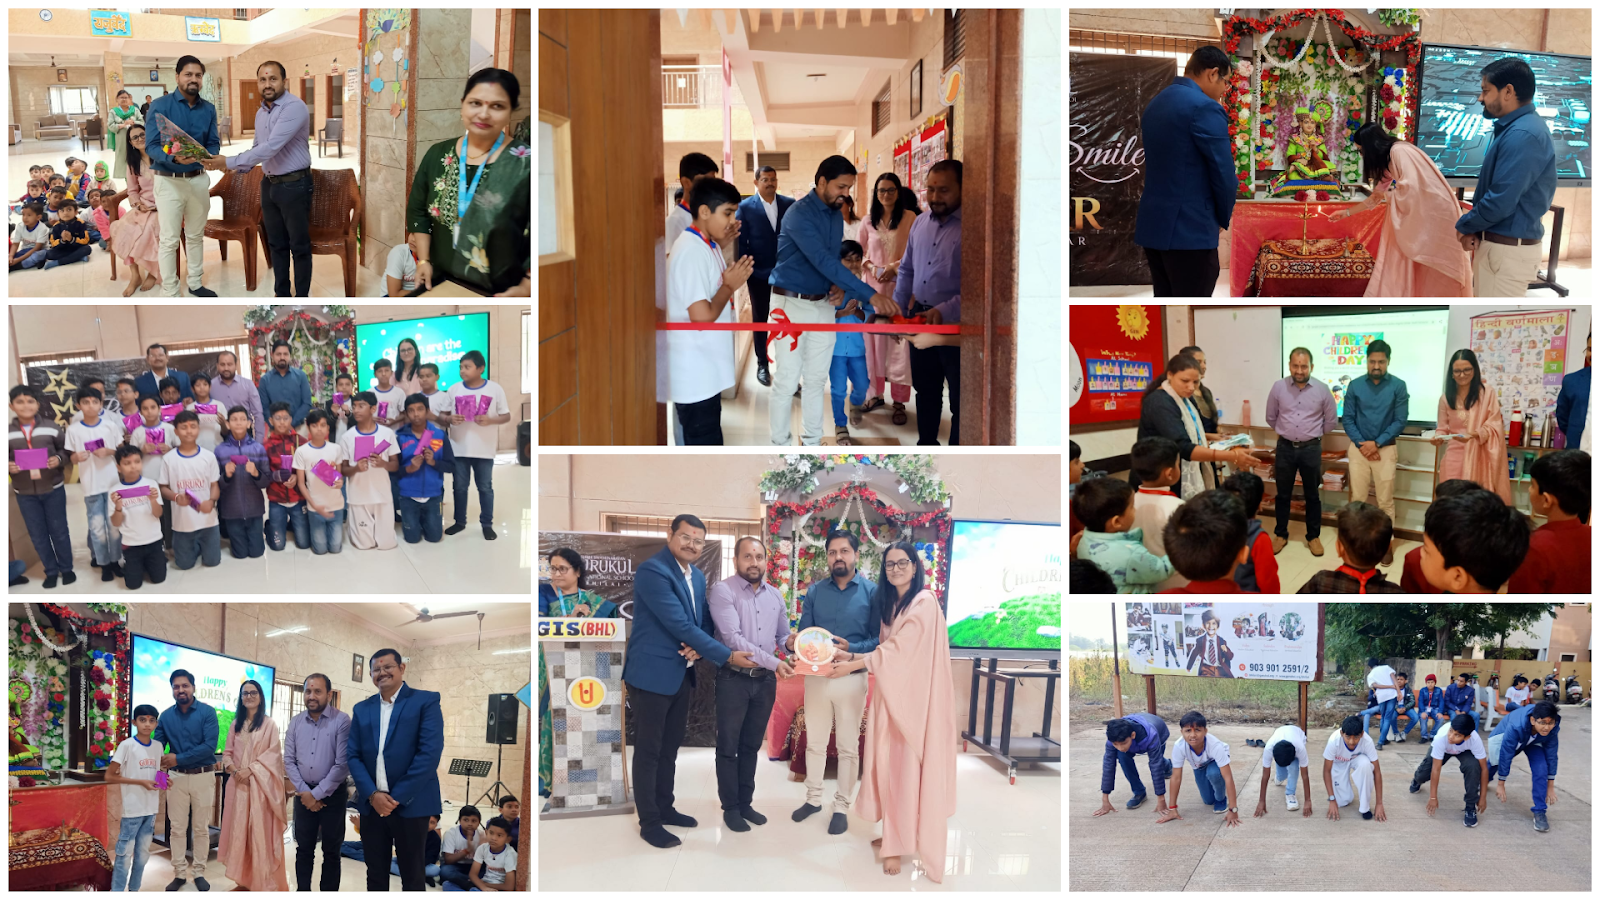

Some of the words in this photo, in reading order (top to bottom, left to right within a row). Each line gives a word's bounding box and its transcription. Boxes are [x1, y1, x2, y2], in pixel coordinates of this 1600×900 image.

[426, 343, 443, 352] are
[444, 338, 462, 350] the
[1331, 335, 1372, 345] HAPPY
[1337, 355, 1365, 365] DAY
[1249, 663, 1264, 671] 903
[1266, 664, 1280, 672] 901
[1282, 664, 1309, 673] 2591/2
[203, 676, 228, 688] Happy
